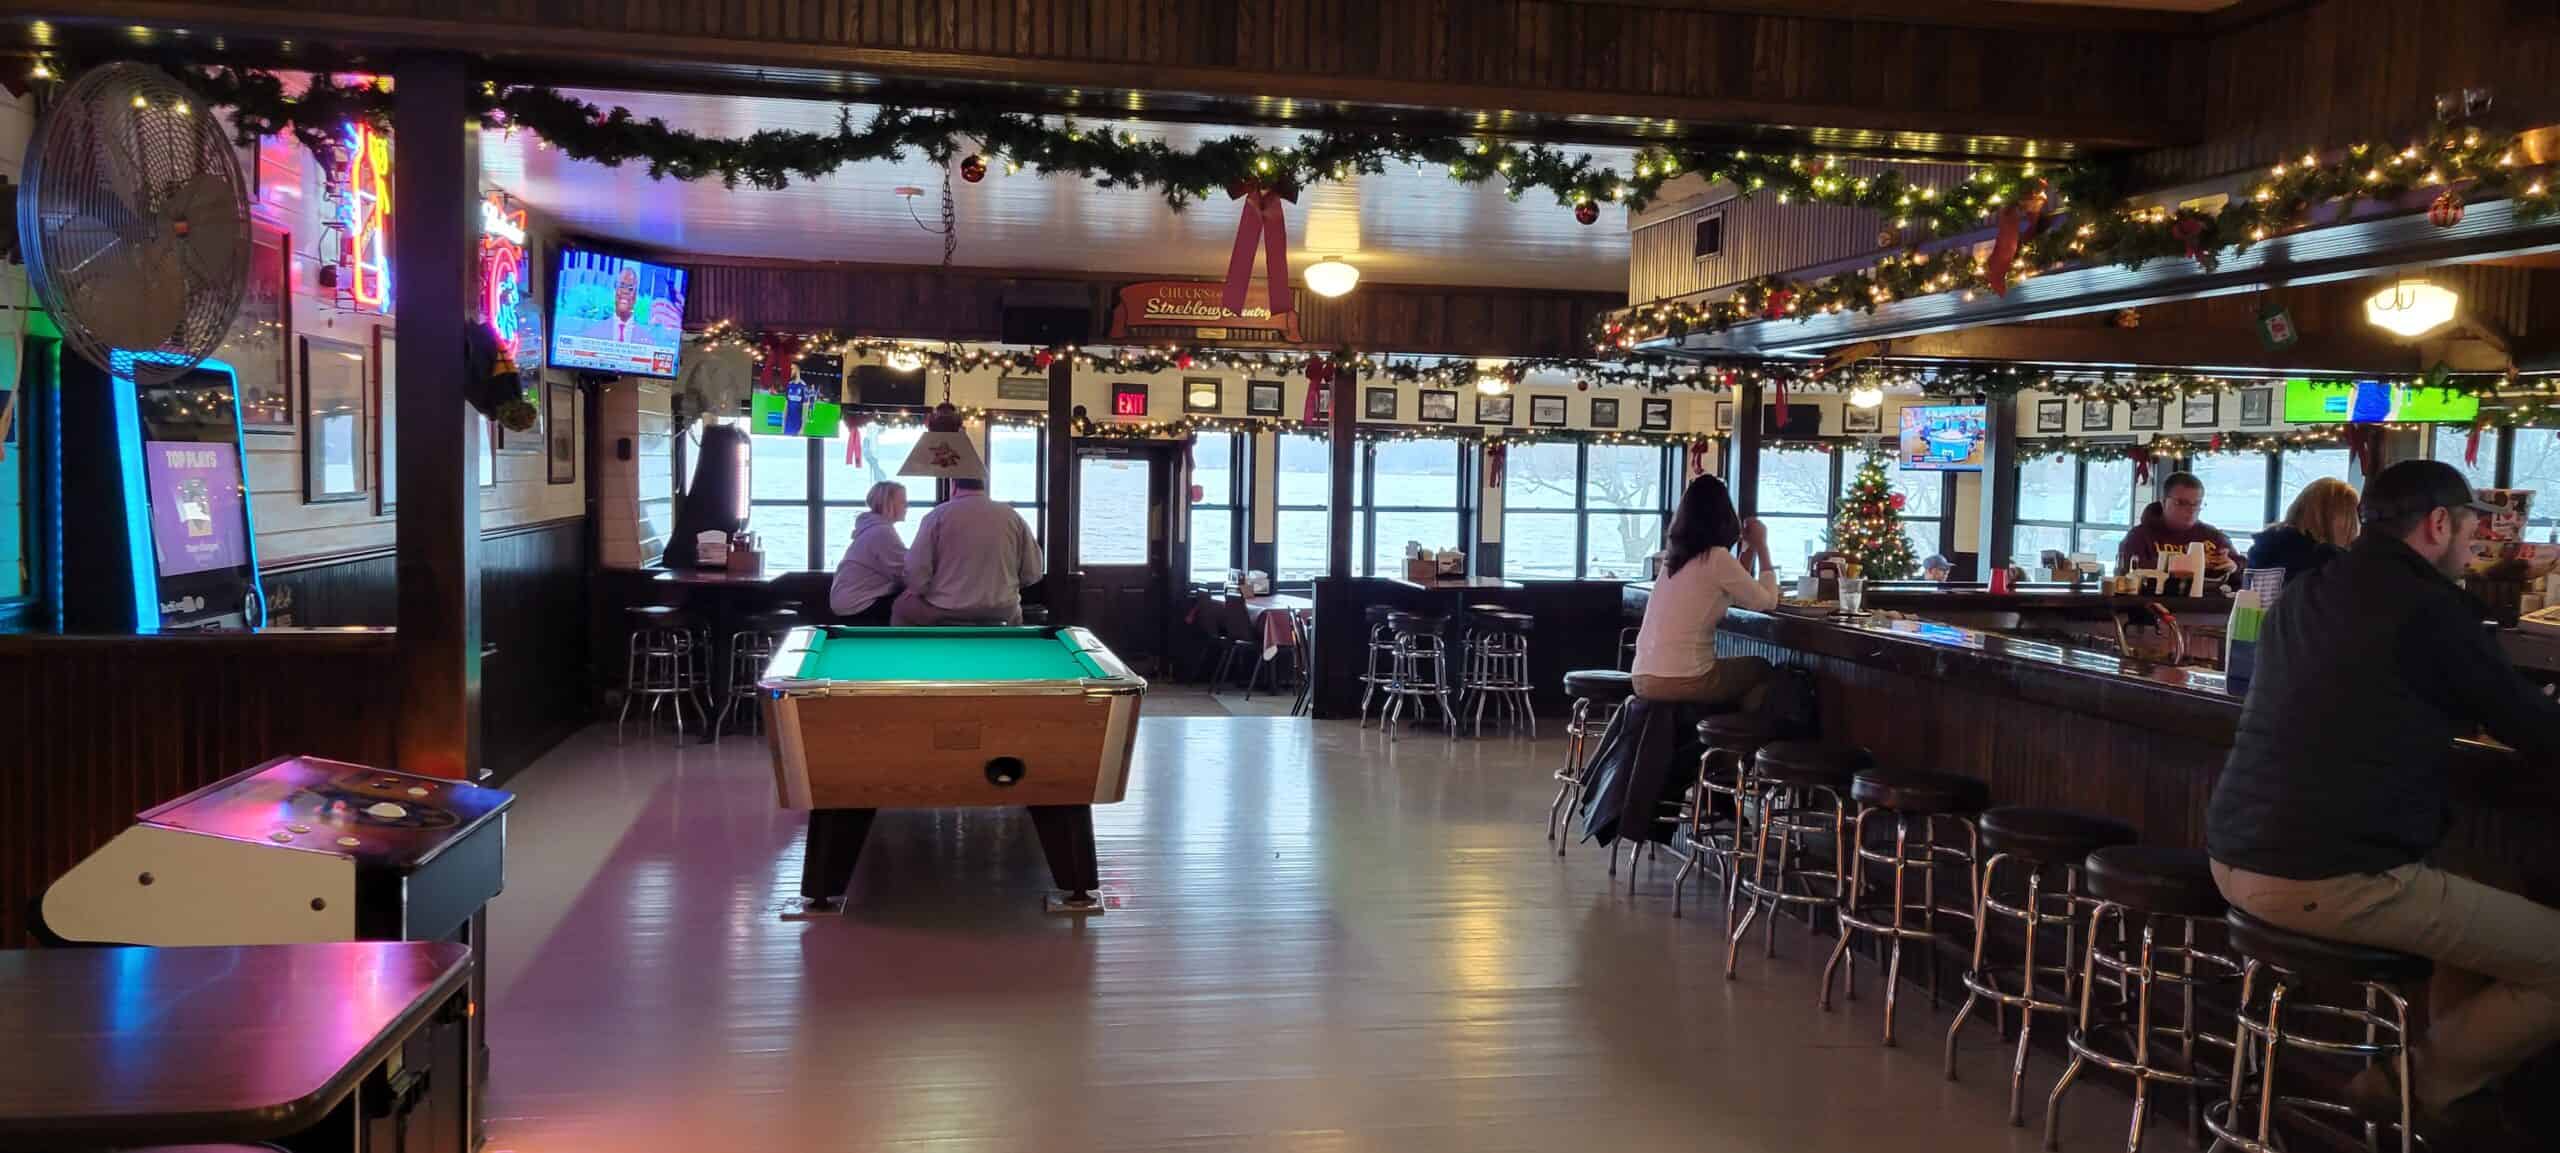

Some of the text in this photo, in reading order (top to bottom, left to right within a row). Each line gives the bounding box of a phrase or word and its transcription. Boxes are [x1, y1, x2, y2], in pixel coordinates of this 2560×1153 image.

[1222, 305, 1272, 321] Cuntry
[1118, 392, 1145, 415] EXIT
[166, 450, 217, 468] TOP PLAYS
